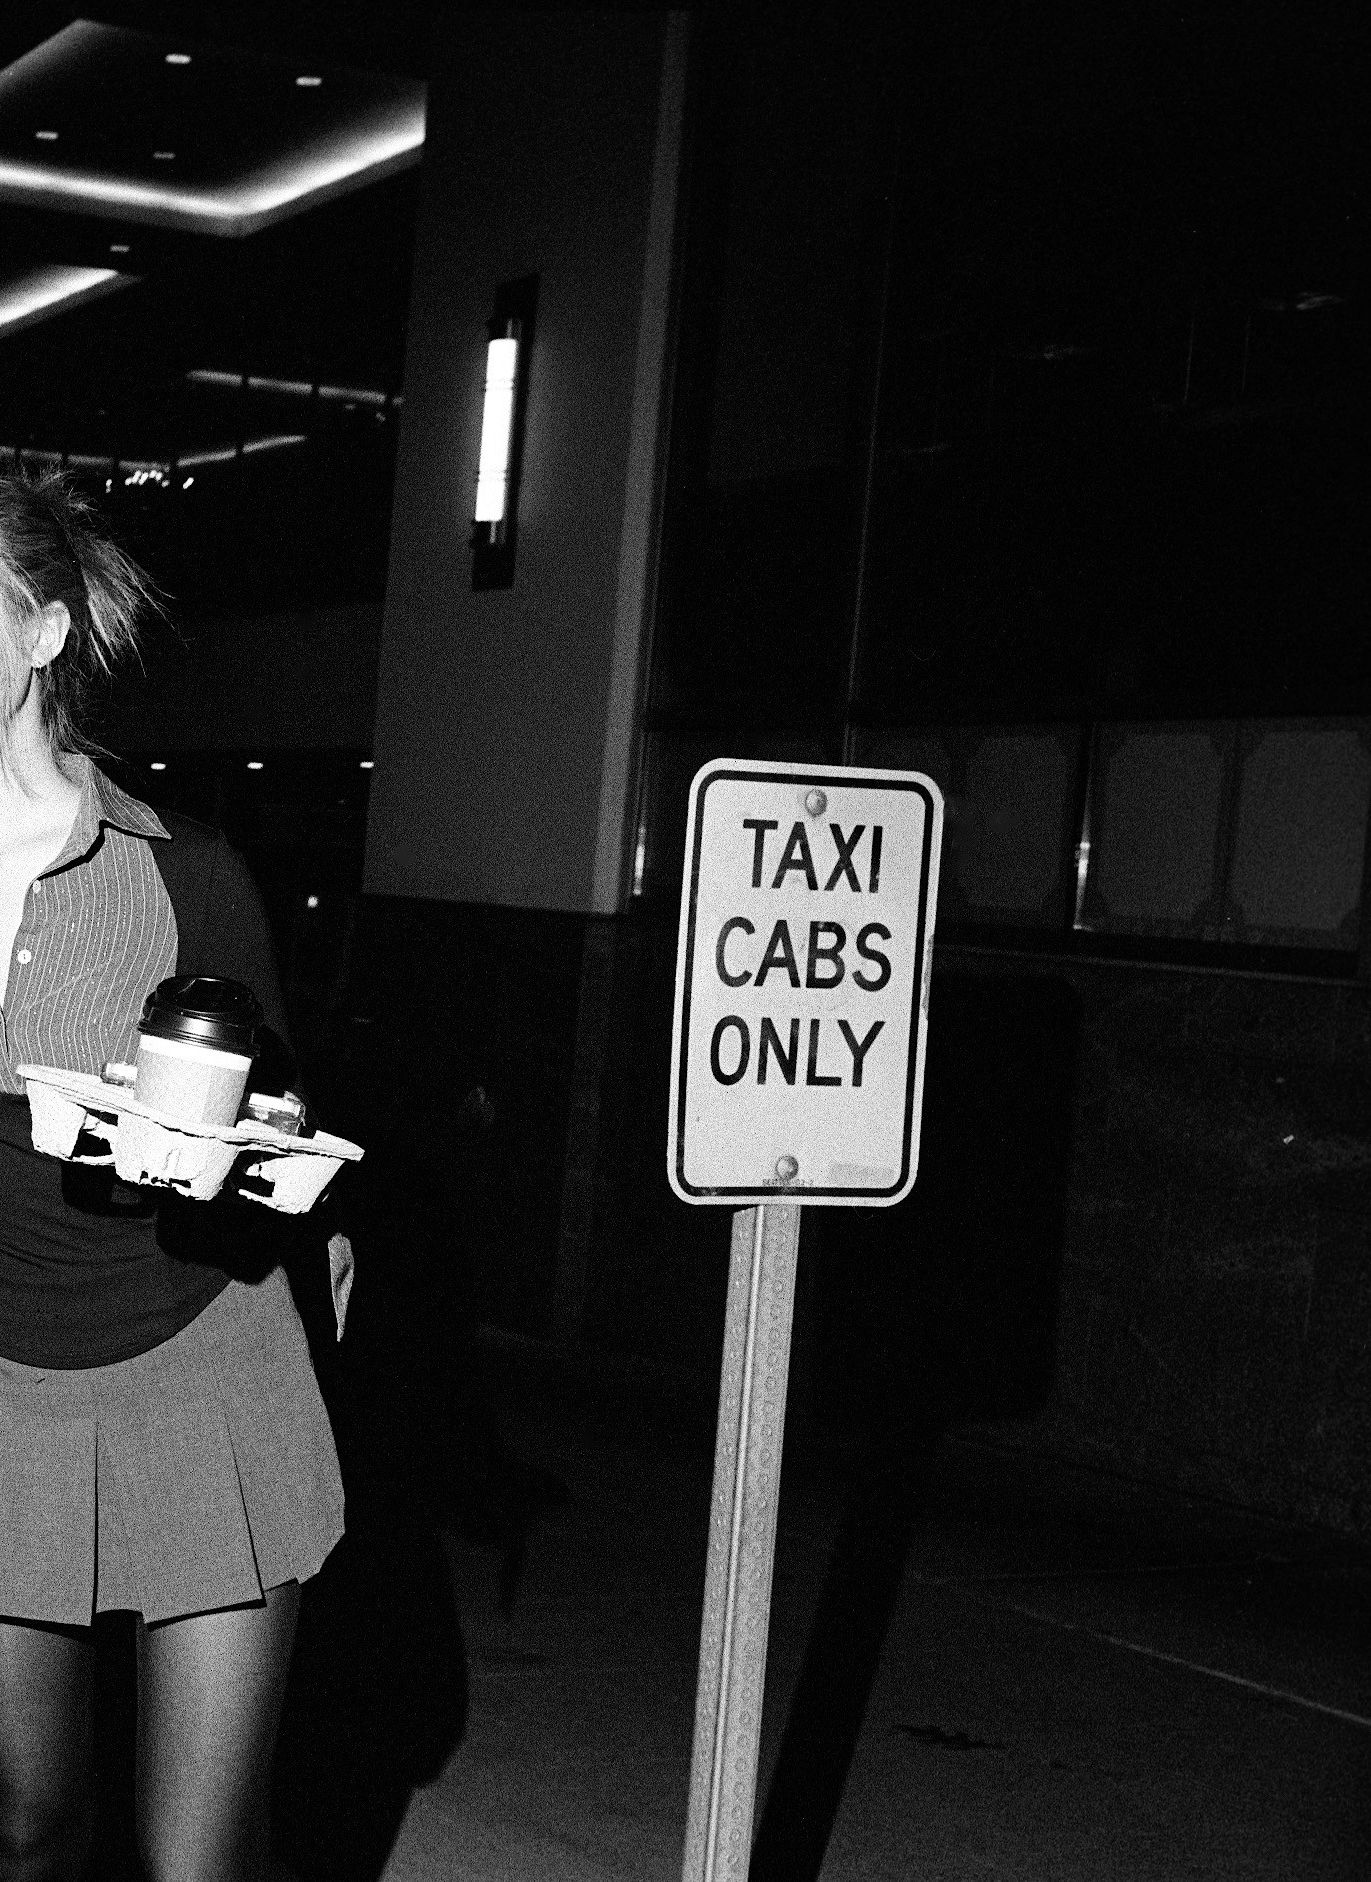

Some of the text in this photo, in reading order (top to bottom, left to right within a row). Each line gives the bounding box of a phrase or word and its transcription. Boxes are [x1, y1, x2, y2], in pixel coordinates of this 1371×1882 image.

[743, 819, 883, 893] TAXI
[716, 917, 891, 992] CABS
[710, 1015, 885, 1087] ONLY
